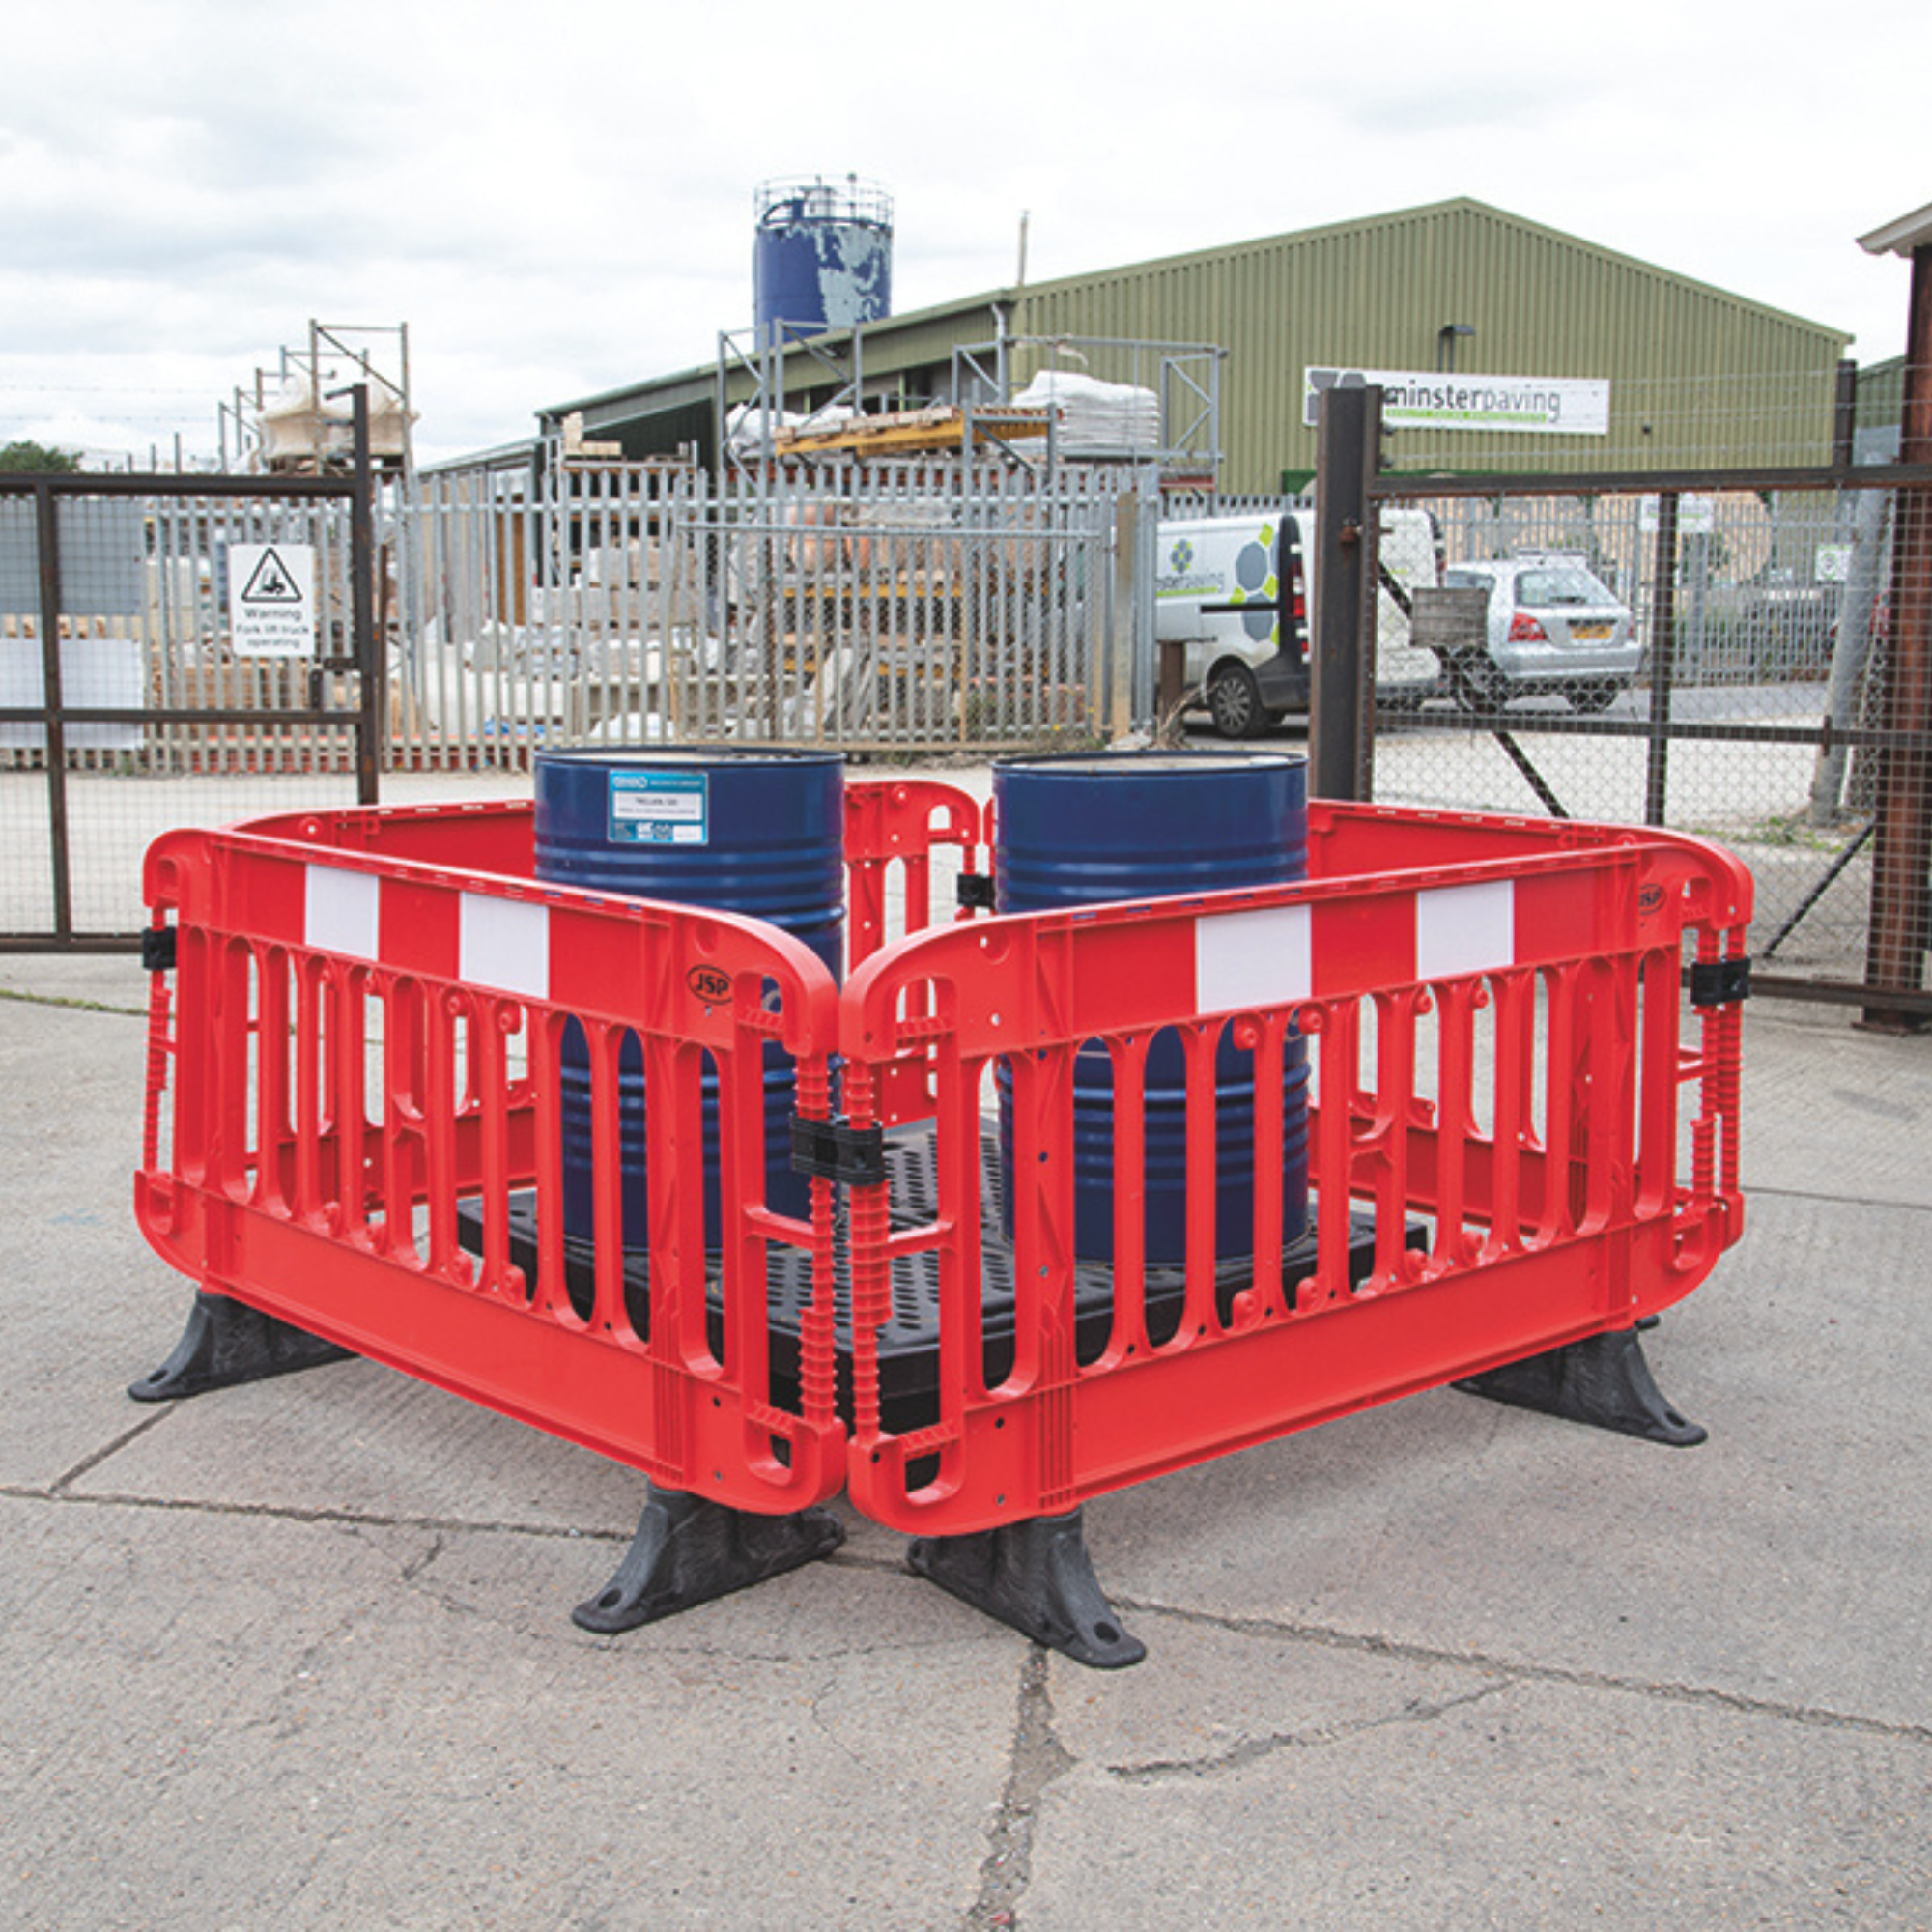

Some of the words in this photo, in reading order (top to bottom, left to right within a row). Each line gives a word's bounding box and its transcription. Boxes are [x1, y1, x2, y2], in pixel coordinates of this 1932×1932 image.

[243, 608, 302, 622] Warning
[236, 623, 261, 635] Fork
[281, 624, 310, 635] truck
[247, 637, 301, 650] operating
[696, 972, 729, 998] JSP
